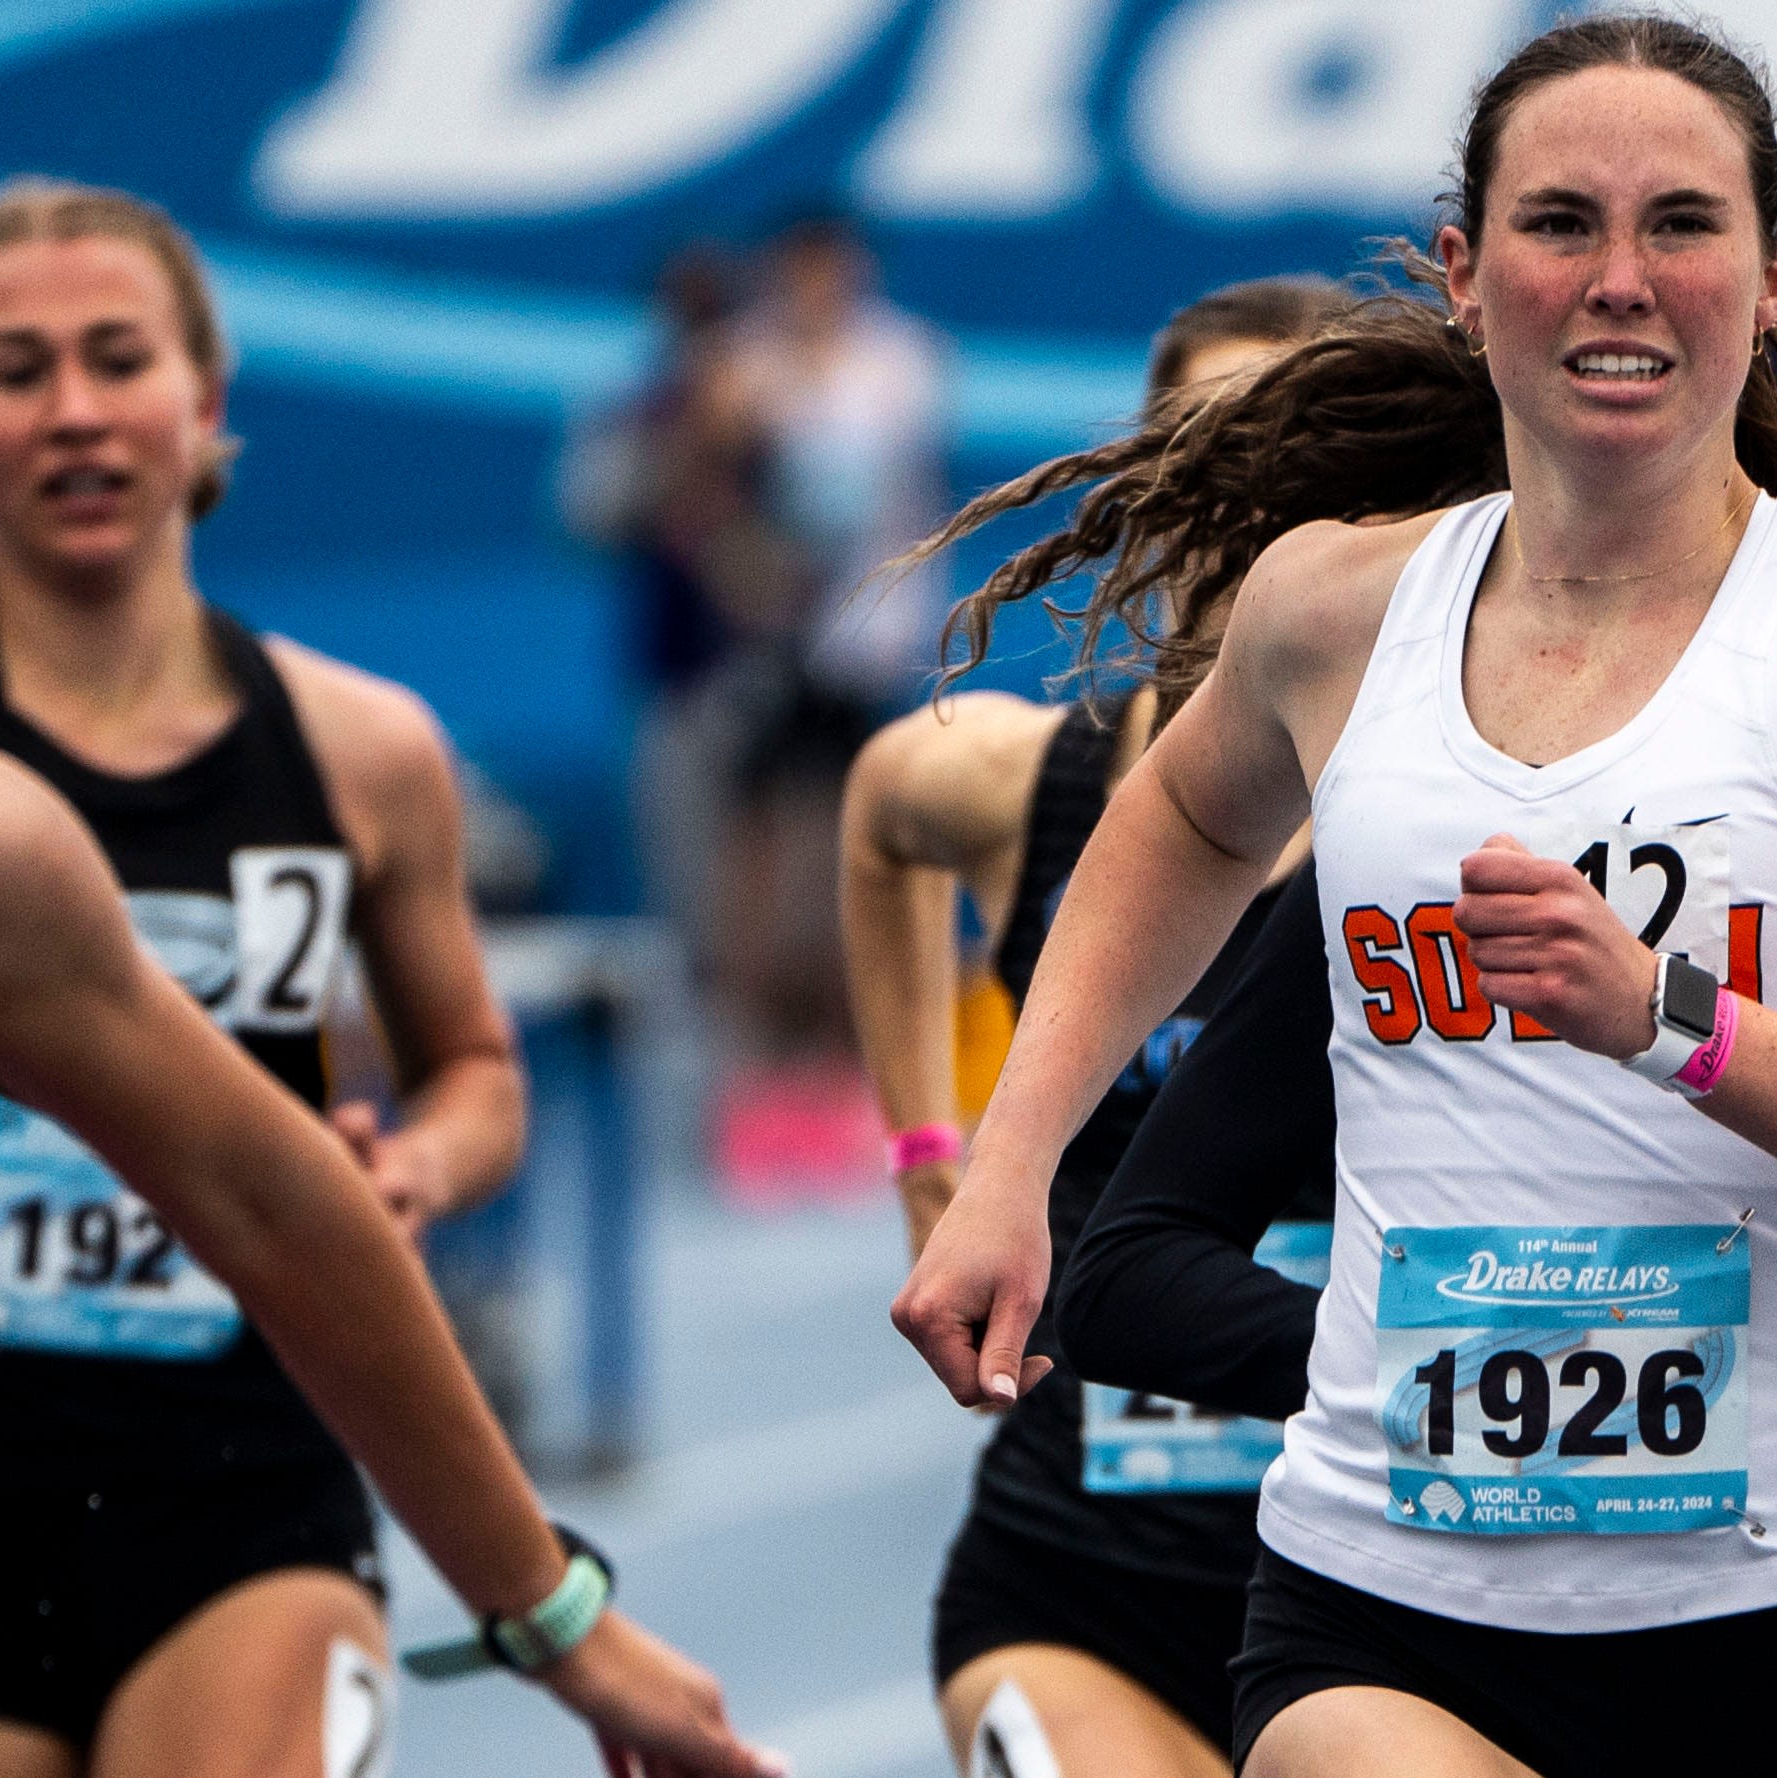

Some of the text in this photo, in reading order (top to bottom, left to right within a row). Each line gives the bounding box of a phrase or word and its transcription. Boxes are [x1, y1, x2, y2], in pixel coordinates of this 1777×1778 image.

[263, 867, 320, 1012] 2
[1551, 1239, 1597, 1253] Annual
[1462, 1250, 1670, 1292] Drake RELAYS
[1414, 1348, 1707, 1458] 1926
[1471, 1488, 1541, 1504] WORLD
[1596, 1498, 1633, 1513] APRIL
[1682, 1496, 1712, 1510] 2024
[1472, 1506, 1576, 1522] ATHLETICS
